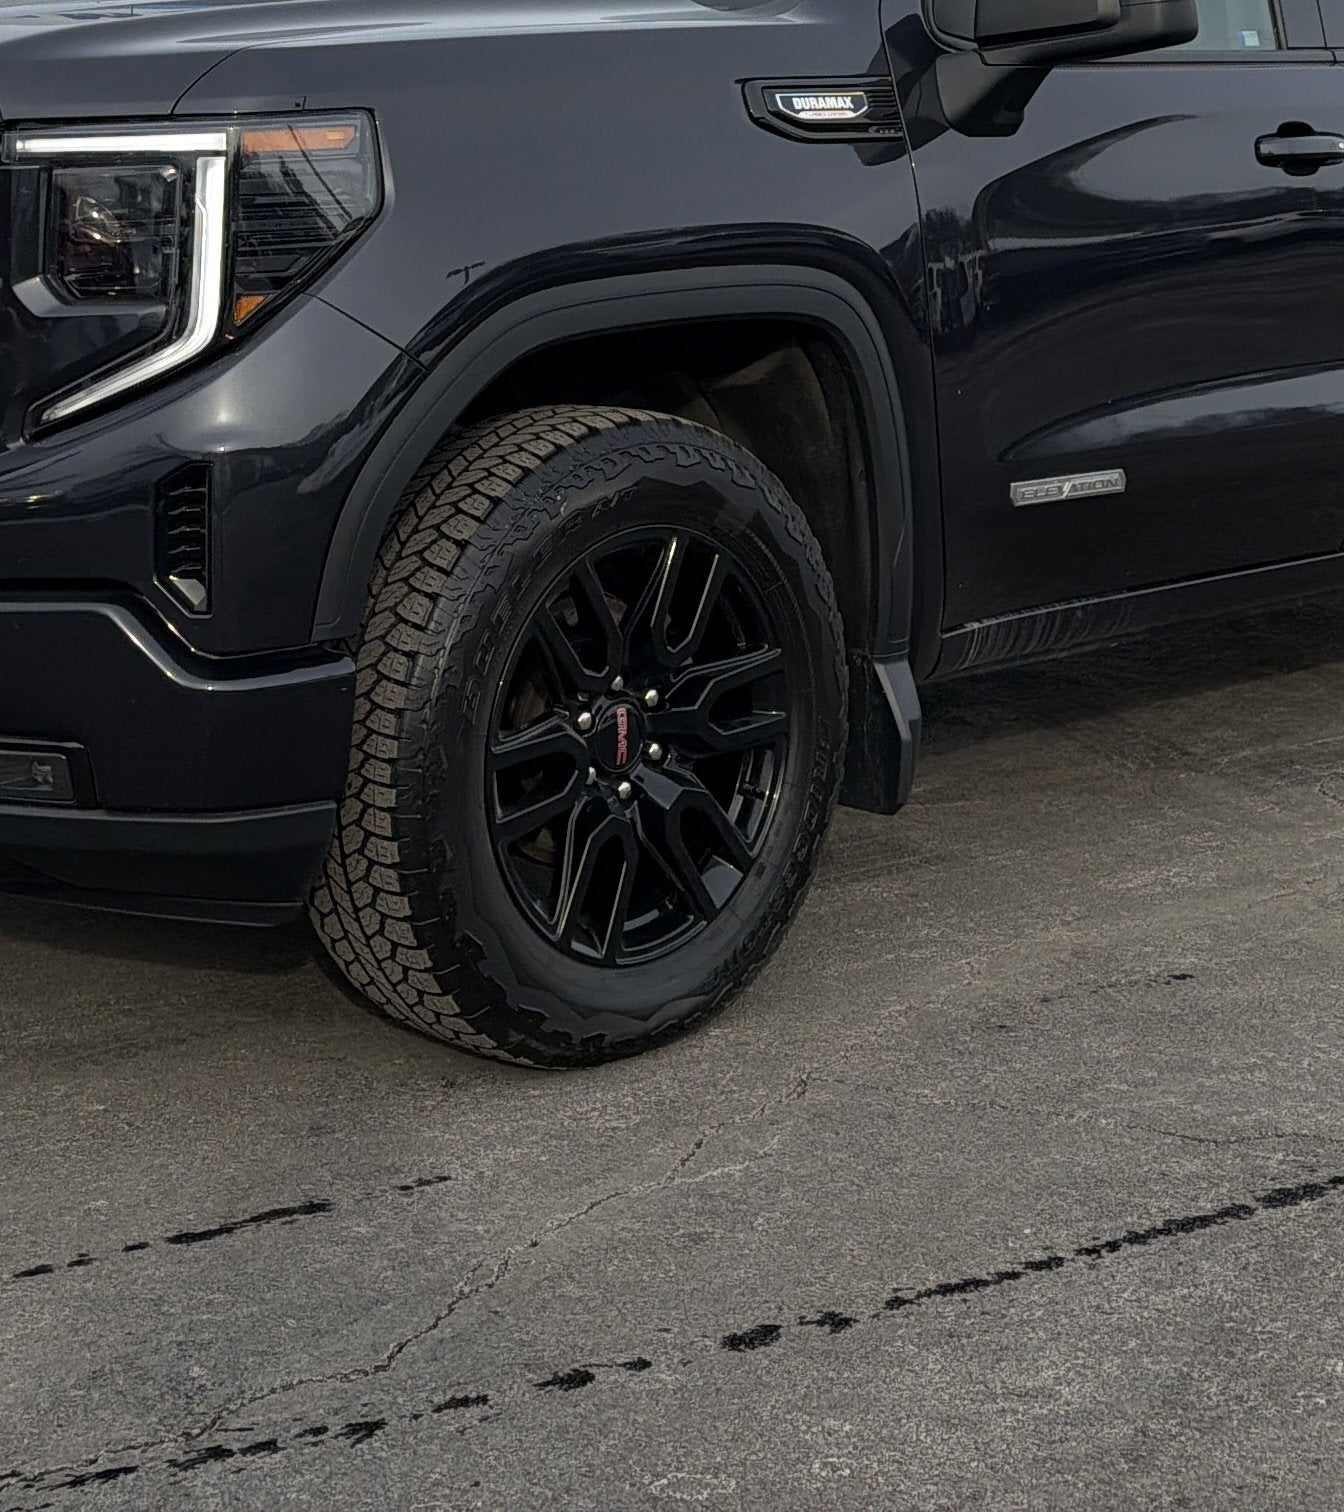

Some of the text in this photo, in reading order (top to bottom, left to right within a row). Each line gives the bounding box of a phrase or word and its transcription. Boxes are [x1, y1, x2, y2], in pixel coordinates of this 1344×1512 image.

[791, 96, 855, 110] DURAMAX
[1021, 477, 1120, 500] ELEVATION
[616, 707, 628, 766] GMC
